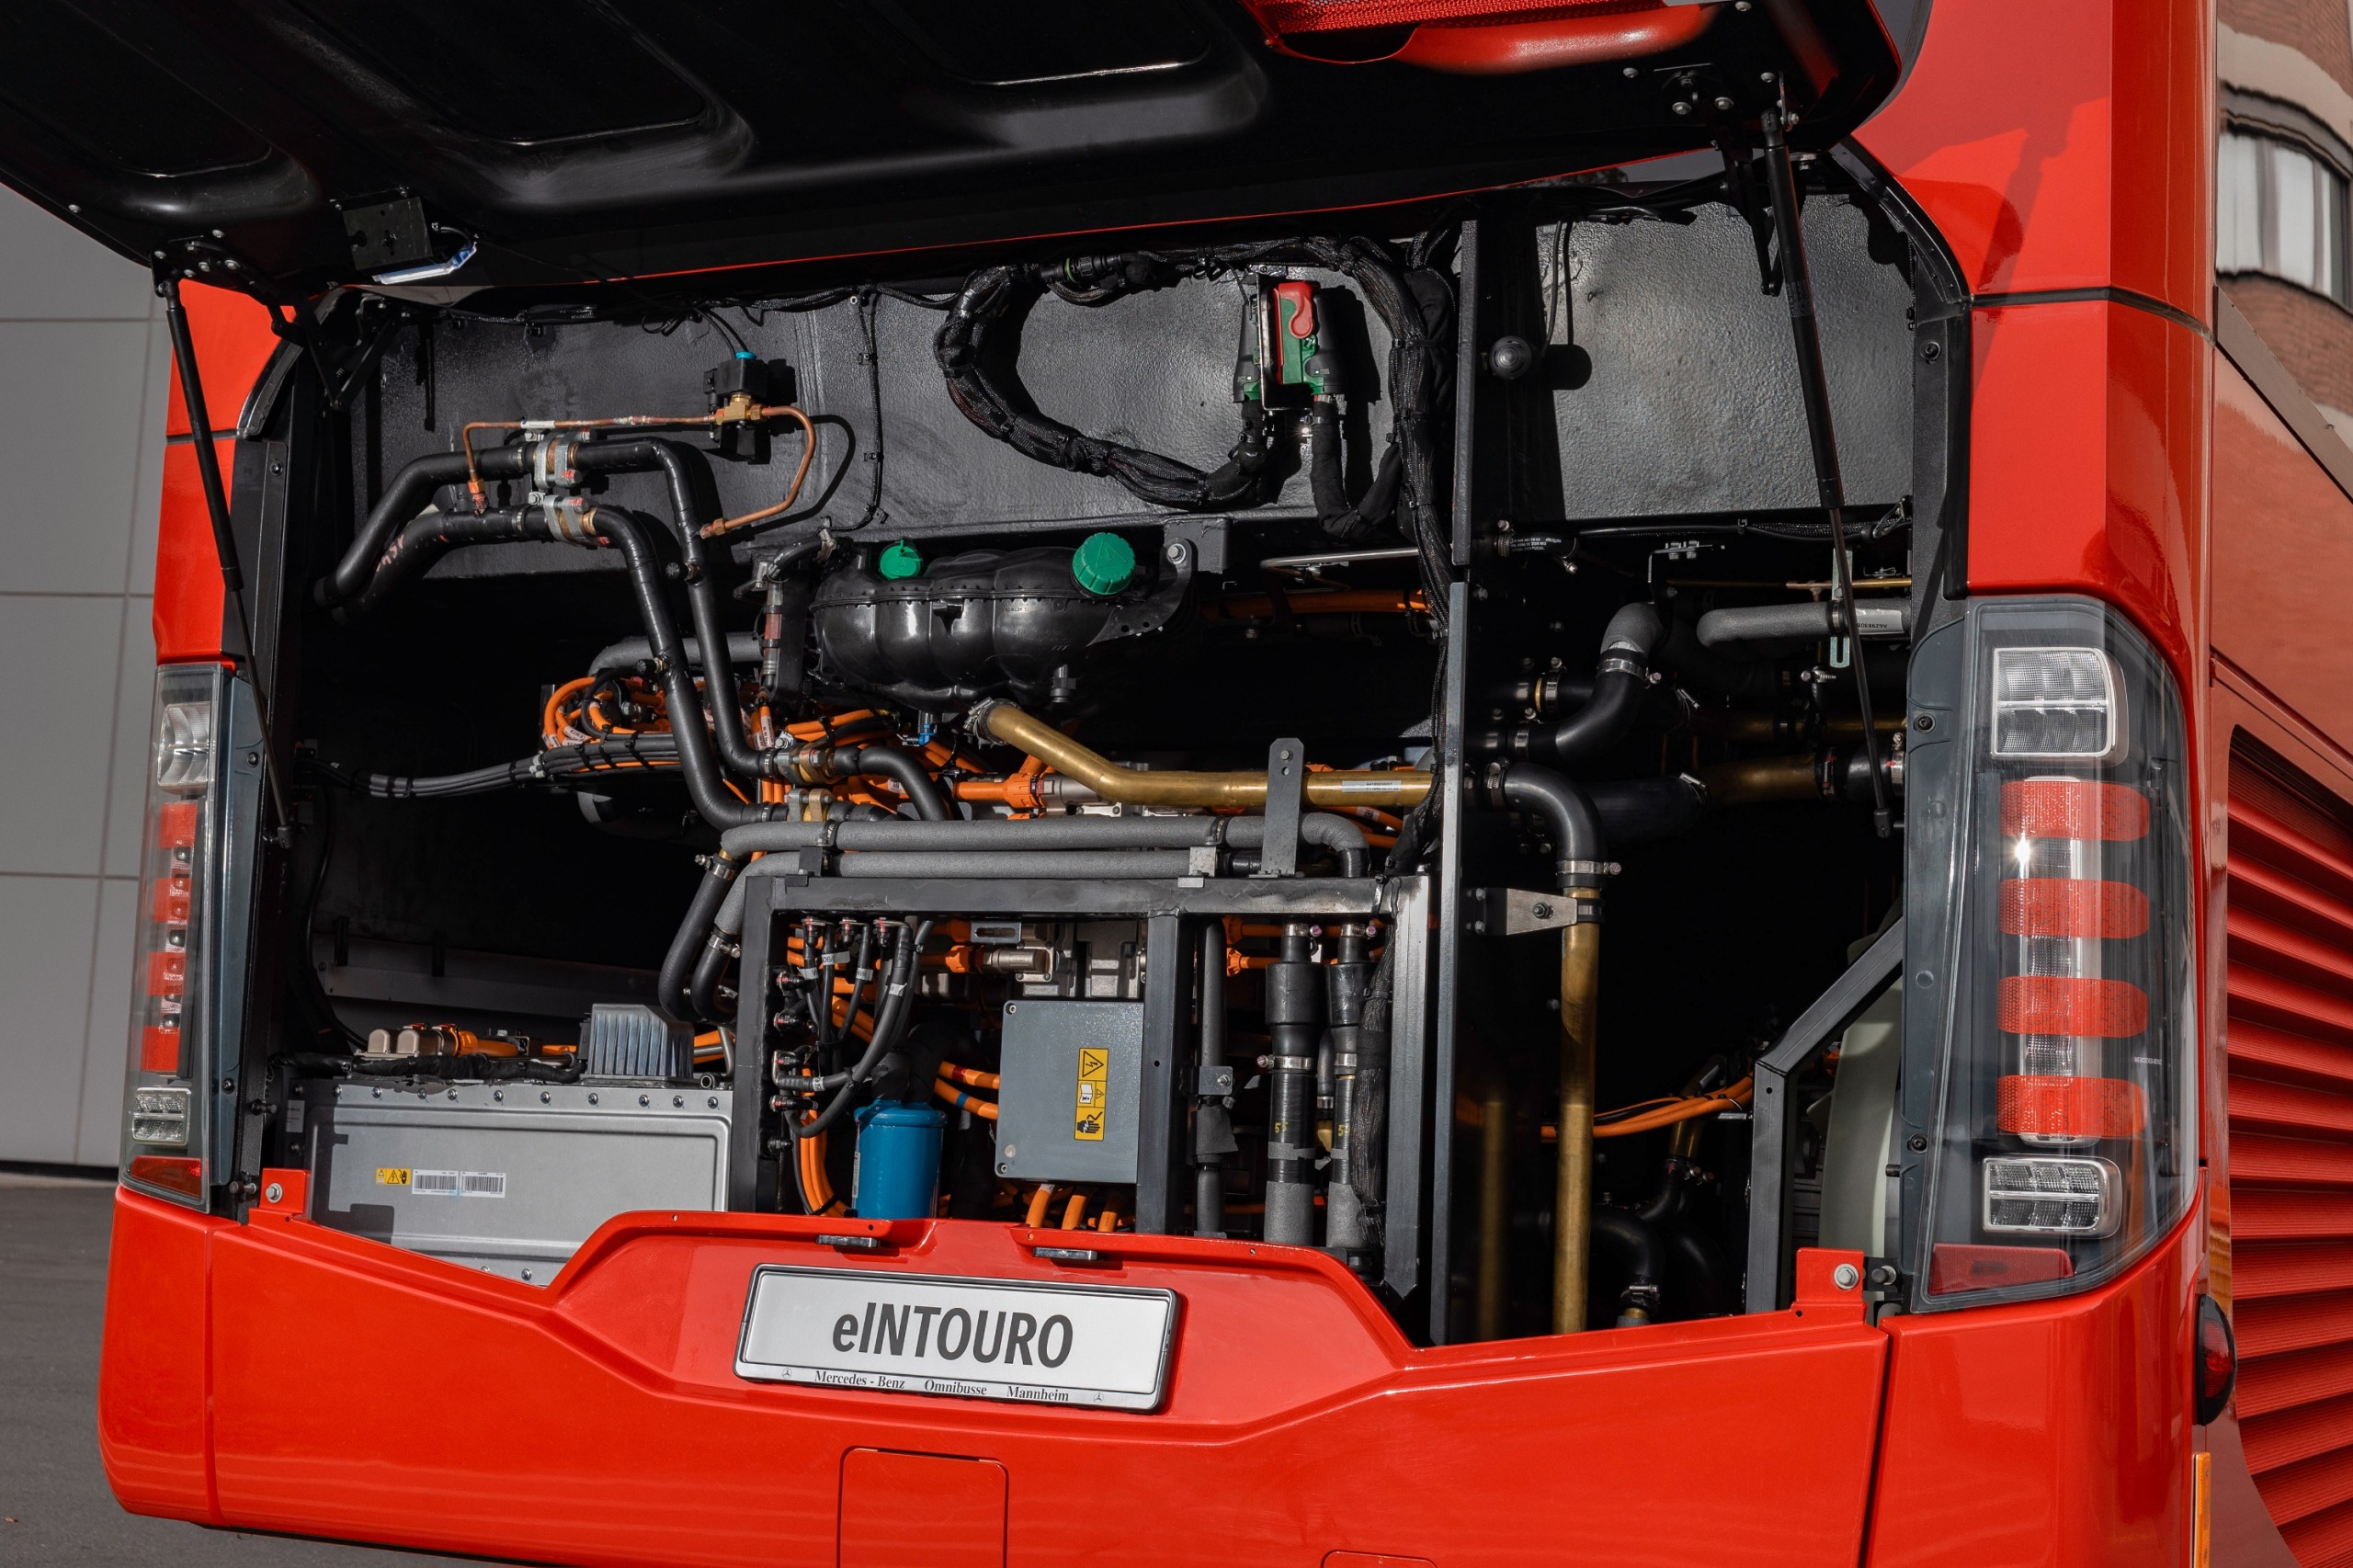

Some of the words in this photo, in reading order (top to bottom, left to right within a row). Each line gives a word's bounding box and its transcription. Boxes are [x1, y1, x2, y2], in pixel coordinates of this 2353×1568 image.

[832, 1301, 1074, 1368] eINTOURO
[924, 1379, 988, 1395] Omnibusse
[1006, 1385, 1070, 1402] Mannheim
